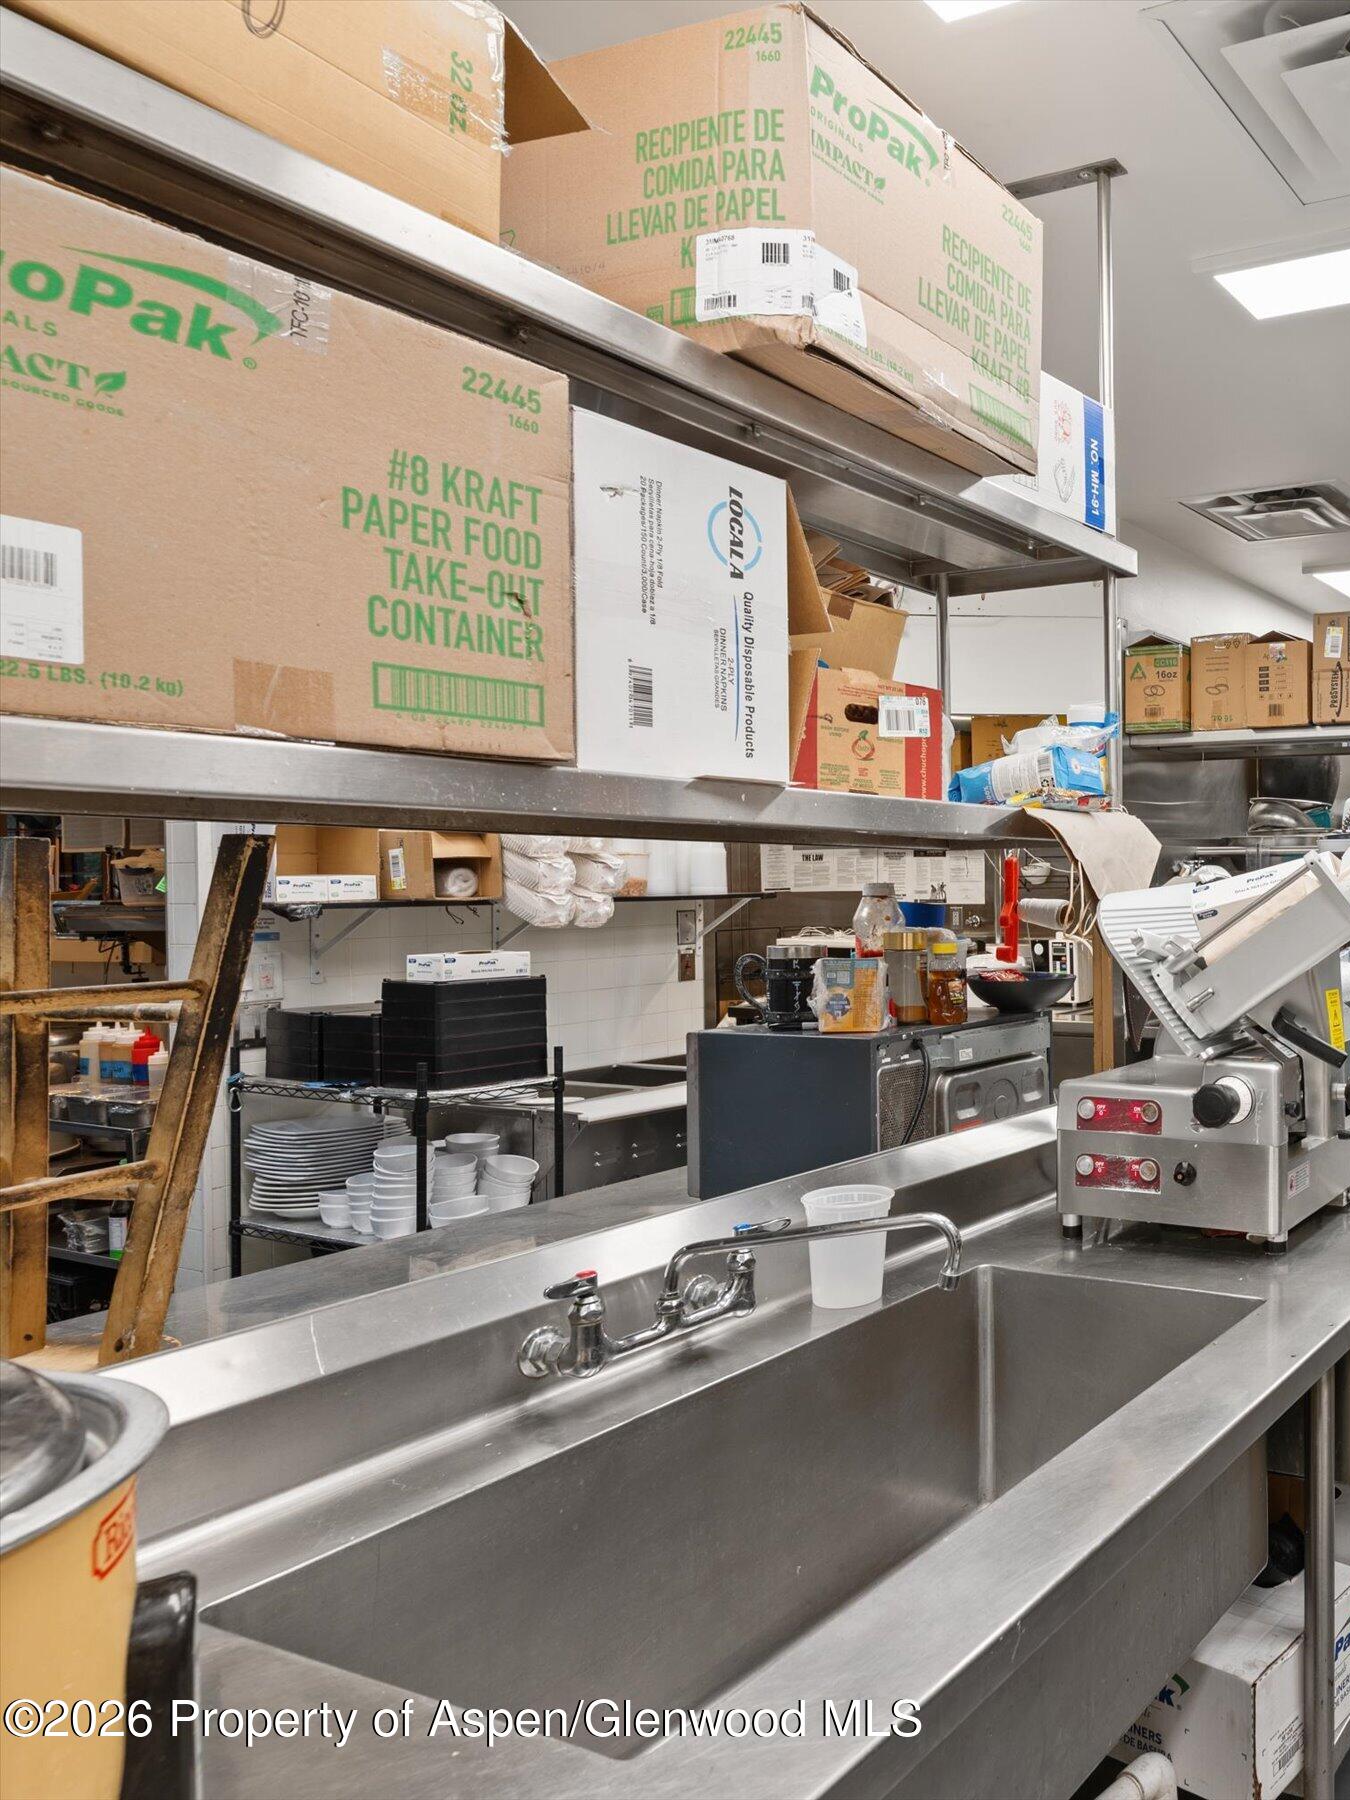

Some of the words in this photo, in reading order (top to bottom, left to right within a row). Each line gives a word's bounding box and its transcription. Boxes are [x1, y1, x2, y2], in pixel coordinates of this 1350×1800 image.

[724, 22, 782, 50] 22445
[756, 50, 781, 62] 1660
[450, 50, 474, 92] 32
[635, 109, 746, 164] RECIPIENTE
[753, 108, 785, 142] DE
[810, 64, 923, 179] ProPak
[810, 105, 864, 153] ORIGINALS
[643, 154, 717, 199] COMIDA
[722, 148, 786, 183] PARA
[811, 128, 874, 187] IMPACT
[606, 201, 678, 246] LLEVAR
[683, 194, 709, 230] DE
[715, 187, 786, 225] PAPEL
[1001, 203, 1033, 241] 22445
[942, 223, 1014, 301] RECIPIENTE
[1017, 281, 1032, 315] DE
[0, 250, 238, 361] oPak
[917, 275, 970, 336] LLEVAR
[974, 313, 991, 349] DE
[993, 328, 1031, 374] PAPEL
[946, 262, 997, 321] COMIDA
[1001, 306, 1032, 345] PARA
[462, 366, 542, 414] 22445
[508, 413, 540, 434] 1660
[1090, 438, 1099, 465] NO.
[387, 448, 429, 497] #8
[441, 462, 543, 525] KRAFT
[647, 478, 655, 519] Servilletas
[655, 481, 664, 507] Dinner
[1090, 469, 1100, 516] MH-91
[341, 485, 452, 551] PAPER
[463, 515, 542, 570] FOOD
[655, 508, 663, 535] Napkin
[655, 536, 663, 557] 2-Ply
[383, 546, 545, 617] TAKE-OUT
[656, 571, 664, 588] Fold
[367, 594, 545, 663] CONTAINER
[742, 590, 755, 633] Quality
[719, 628, 728, 666] DINNER
[743, 636, 756, 702] Disposable
[46, 665, 93, 686] LBS.
[100, 672, 151, 691] (10.2
[156, 678, 184, 698] kg)
[719, 668, 728, 711] NAPKINS
[727, 657, 735, 685] 2-PLY
[1155, 670, 1178, 680] 16oz
[744, 705, 756, 758] Products
[801, 854, 812, 862] THE
[812, 853, 824, 861] LAW
